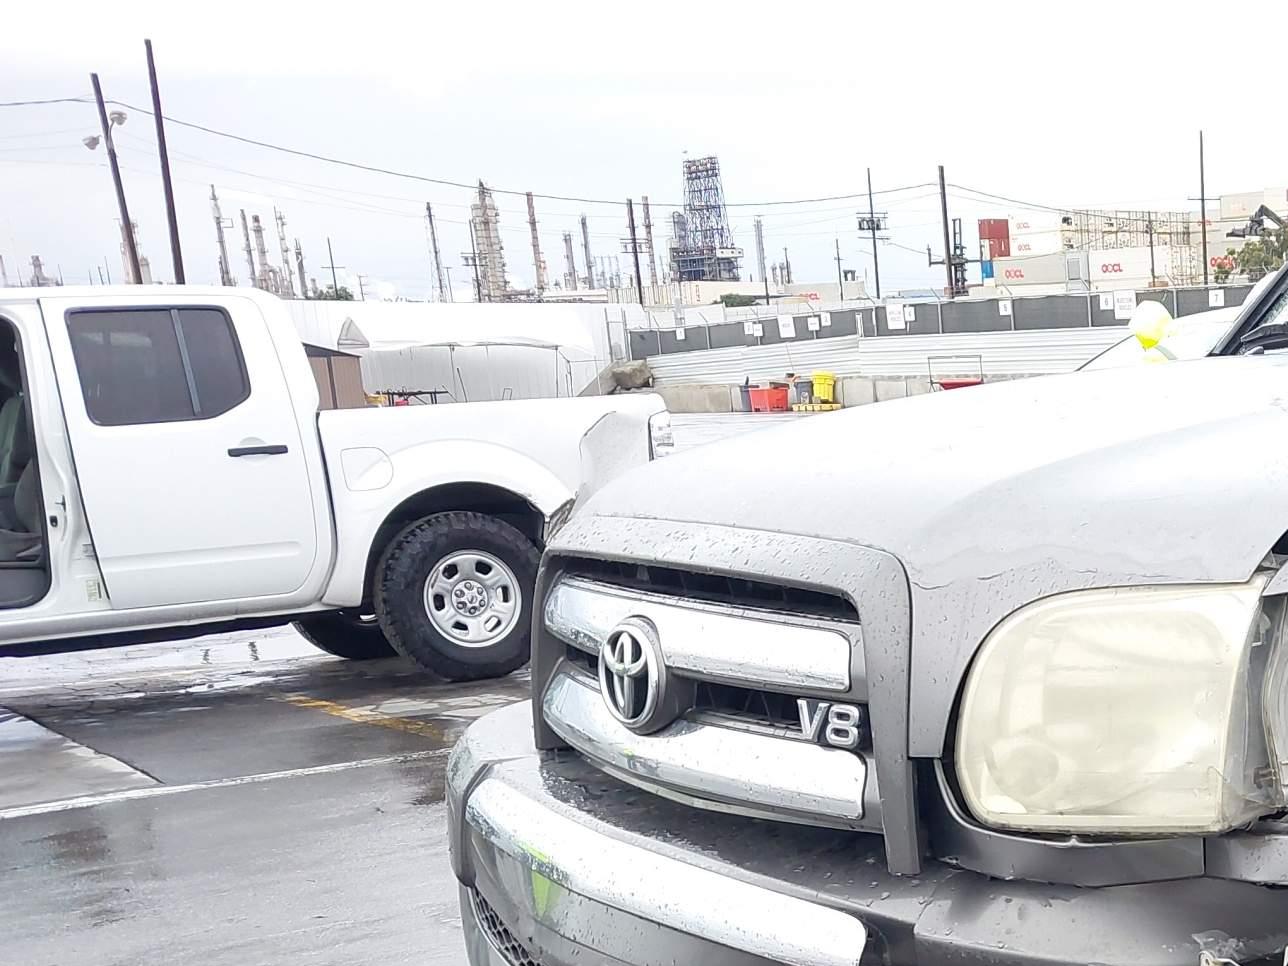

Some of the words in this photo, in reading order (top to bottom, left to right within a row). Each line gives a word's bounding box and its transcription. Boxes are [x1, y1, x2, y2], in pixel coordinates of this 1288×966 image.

[1101, 263, 1123, 273] OOCL
[1004, 269, 1025, 279] OOCL
[797, 699, 861, 750] V8
